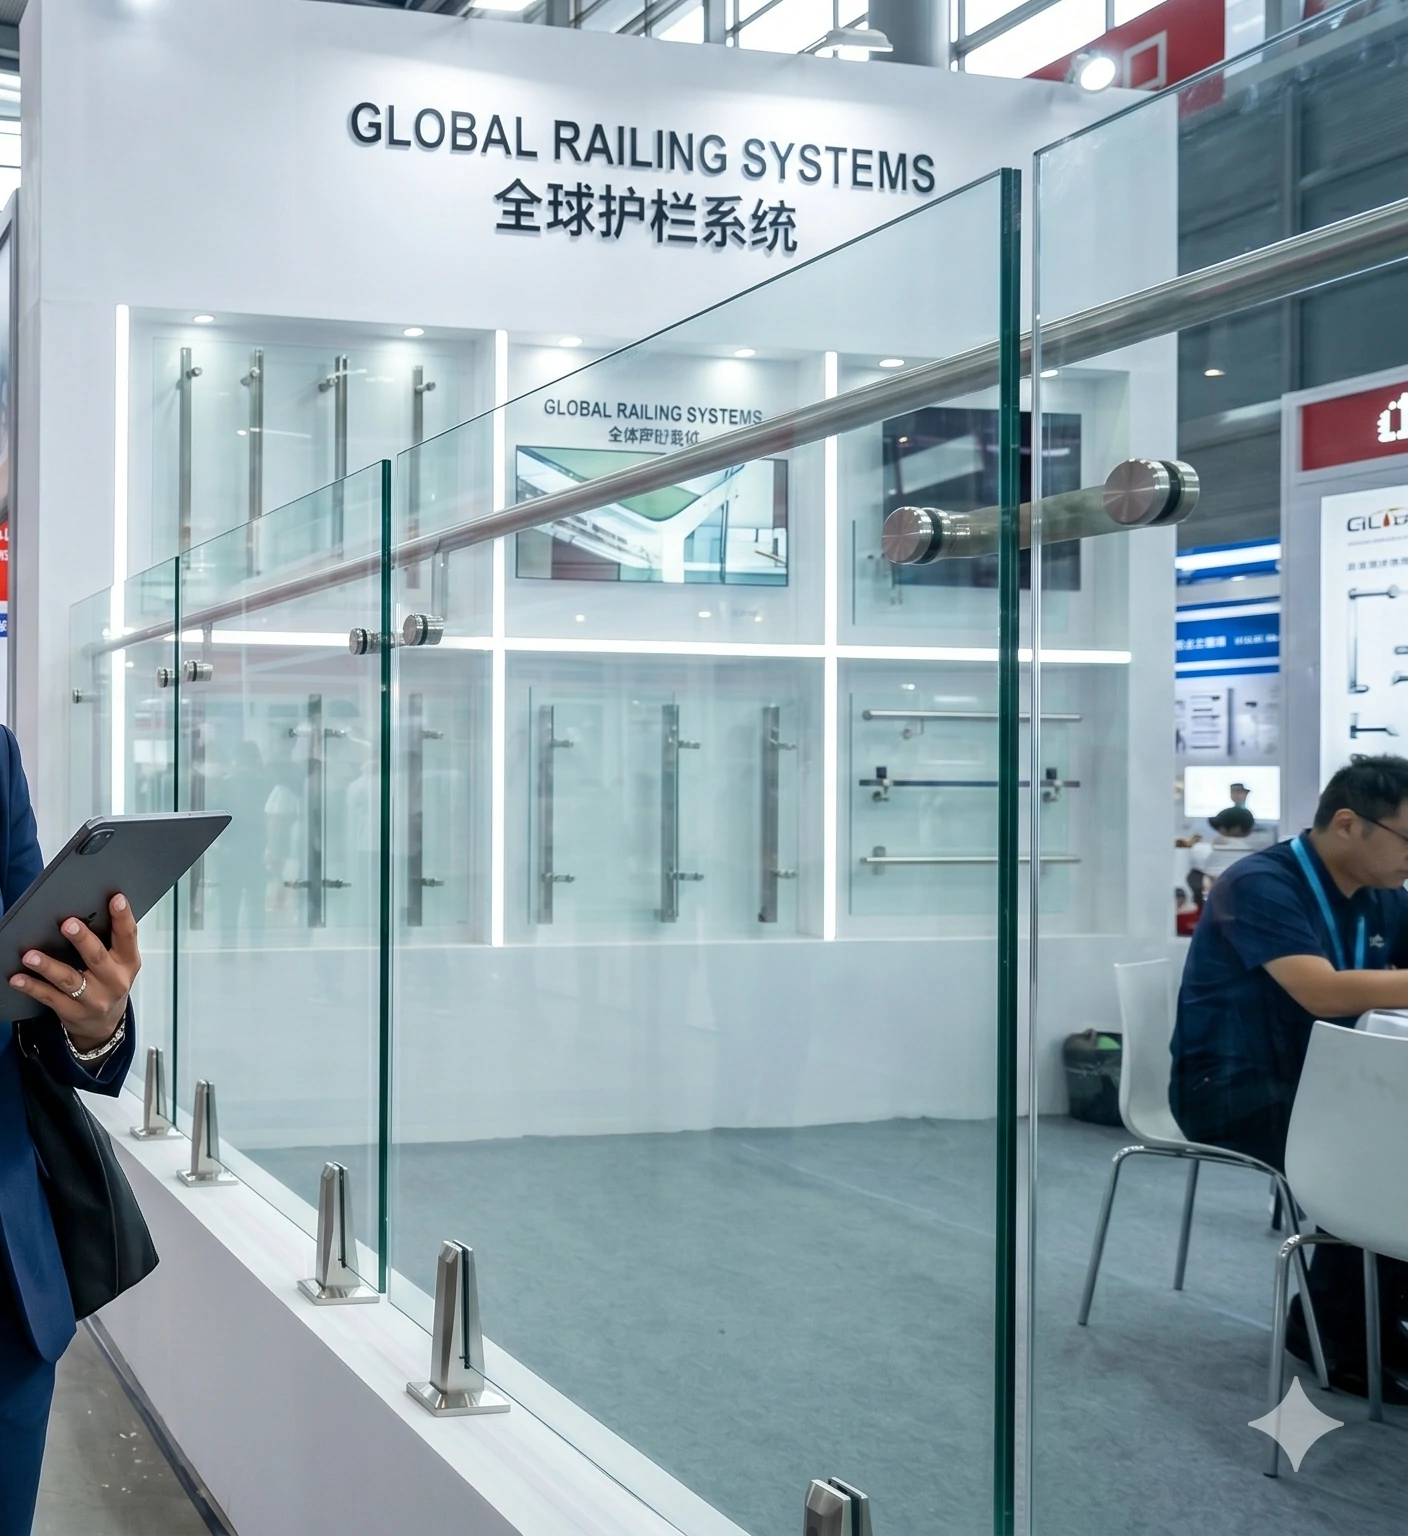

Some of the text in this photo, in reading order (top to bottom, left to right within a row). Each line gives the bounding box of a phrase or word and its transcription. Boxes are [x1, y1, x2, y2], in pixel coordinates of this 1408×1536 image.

[349, 102, 936, 194] GLOBAL RAILING SYSTEMS
[494, 178, 798, 253] 全球护栏系统
[544, 399, 763, 425] GLOBAL RAILING SYSTEMS
